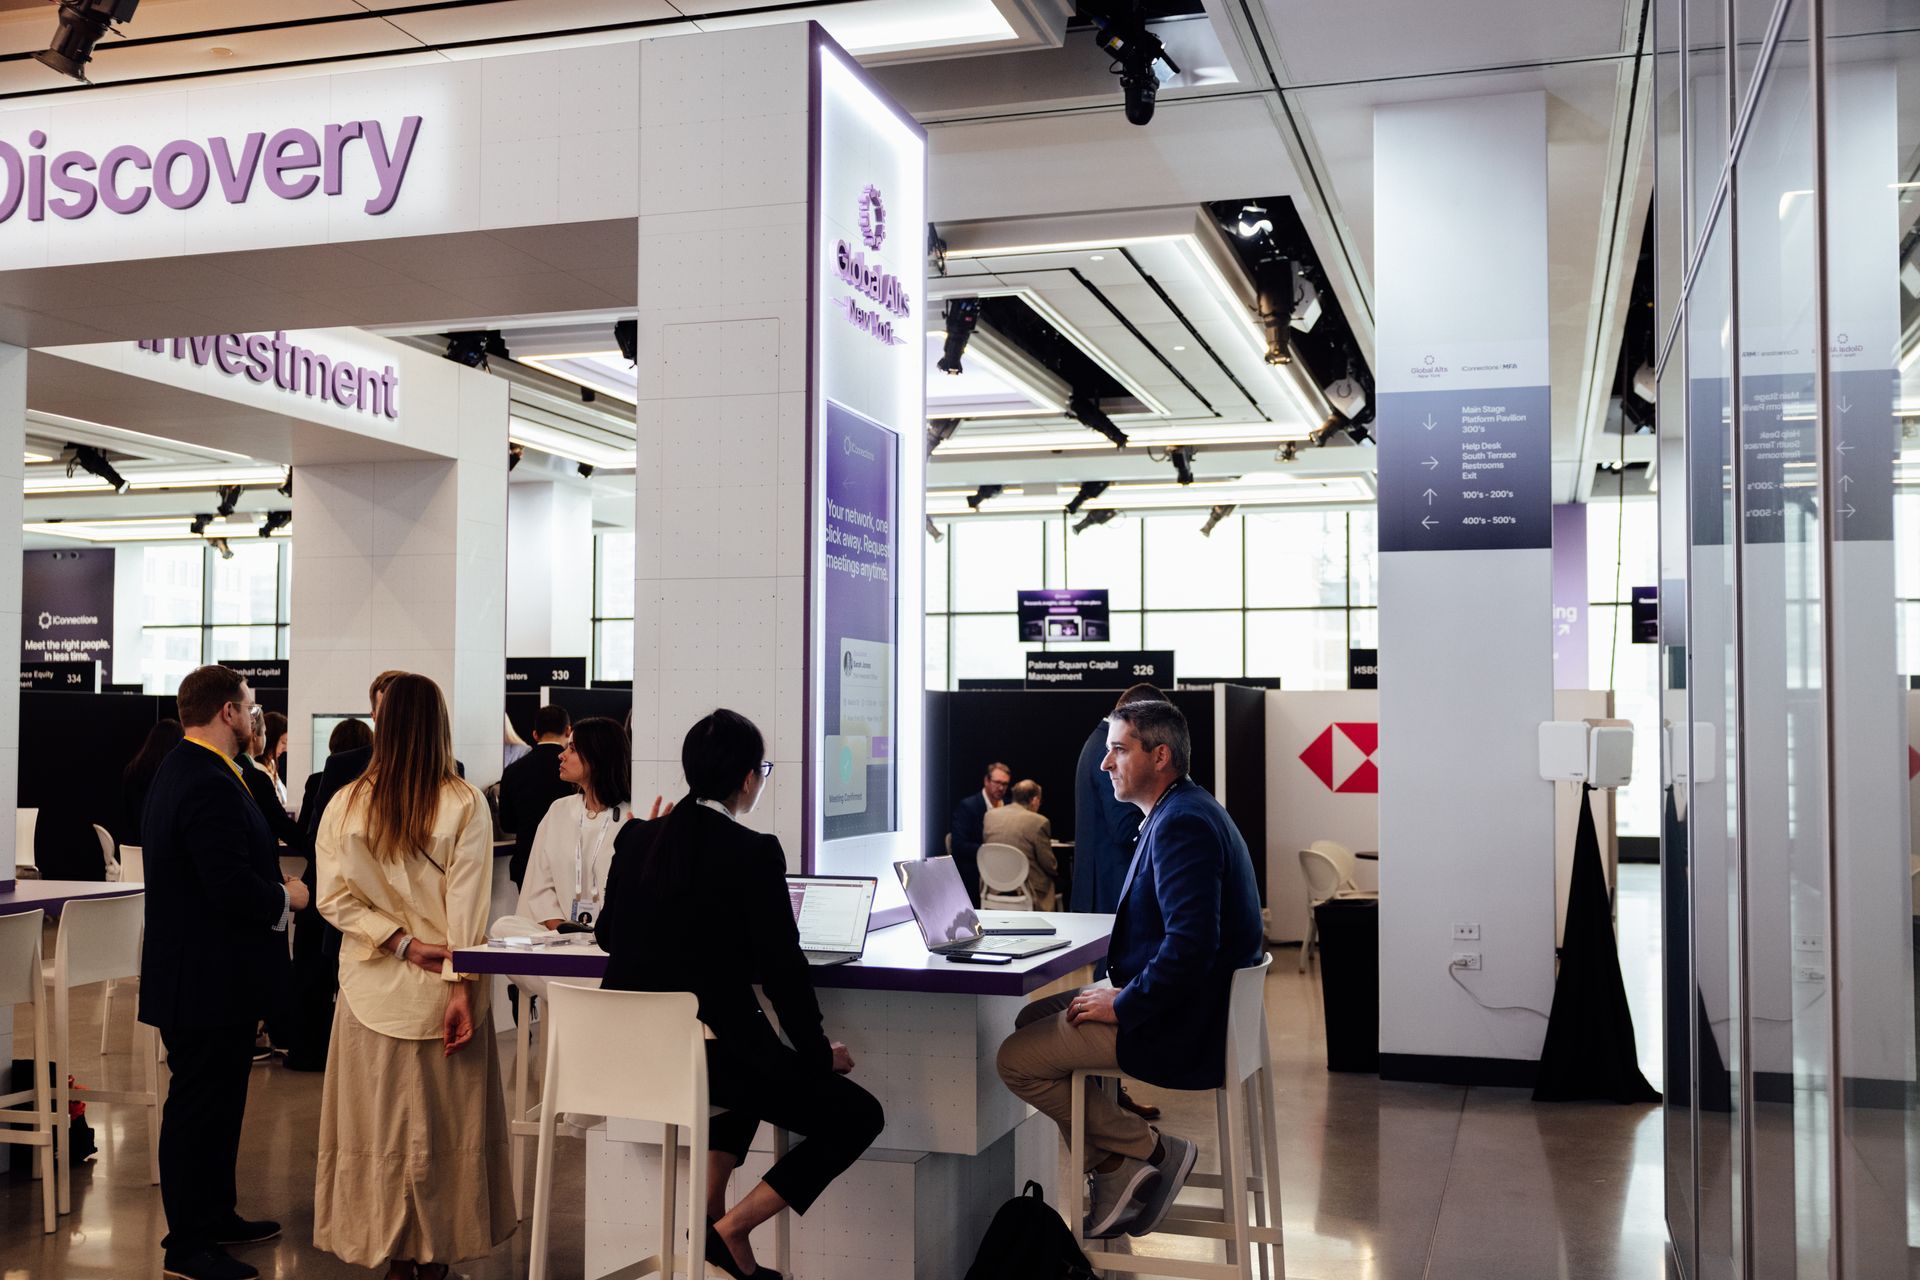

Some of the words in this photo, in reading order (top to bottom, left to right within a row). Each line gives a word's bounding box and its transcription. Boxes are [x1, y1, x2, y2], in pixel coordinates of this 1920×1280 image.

[831, 239, 882, 305] Global
[881, 274, 910, 318] Alts
[844, 296, 871, 331] New
[869, 311, 895, 345] York
[137, 330, 399, 418] vestment
[1411, 366, 1433, 375] Global
[1462, 406, 1481, 414] Main
[1482, 405, 1506, 414] Stage
[1462, 415, 1495, 423] Platform
[1496, 414, 1527, 422] Pavilion
[1462, 425, 1486, 433] 300's
[1462, 443, 1480, 451] Help
[1462, 452, 1486, 460] South
[1462, 491, 1484, 499] 100's
[1490, 490, 1514, 498] 200's
[827, 498, 844, 520] Your
[845, 508, 875, 533] network,
[875, 518, 889, 534] one
[1462, 517, 1486, 525] 400's
[1492, 516, 1516, 524] 500's
[825, 524, 842, 545] click
[842, 531, 862, 555] away.
[863, 534, 891, 559] Request
[826, 554, 860, 578] meetings
[860, 560, 889, 582] anytime.
[53, 614, 98, 625] iConnections
[25, 640, 46, 651] Meet
[47, 640, 60, 650] the
[61, 639, 80, 652] right
[81, 639, 110, 652] people.
[44, 651, 52, 661] In
[53, 651, 69, 661] less
[70, 650, 90, 661] time.
[1028, 660, 1056, 669] Palmer
[1058, 660, 1087, 671] Square
[1089, 660, 1118, 670] Capital
[1133, 664, 1154, 676] 326
[34, 670, 54, 679] Equity
[256, 668, 280, 677] Capital
[505, 672, 528, 680] estors
[552, 670, 569, 680] 330
[1028, 672, 1082, 682] Management
[67, 673, 81, 683] 334
